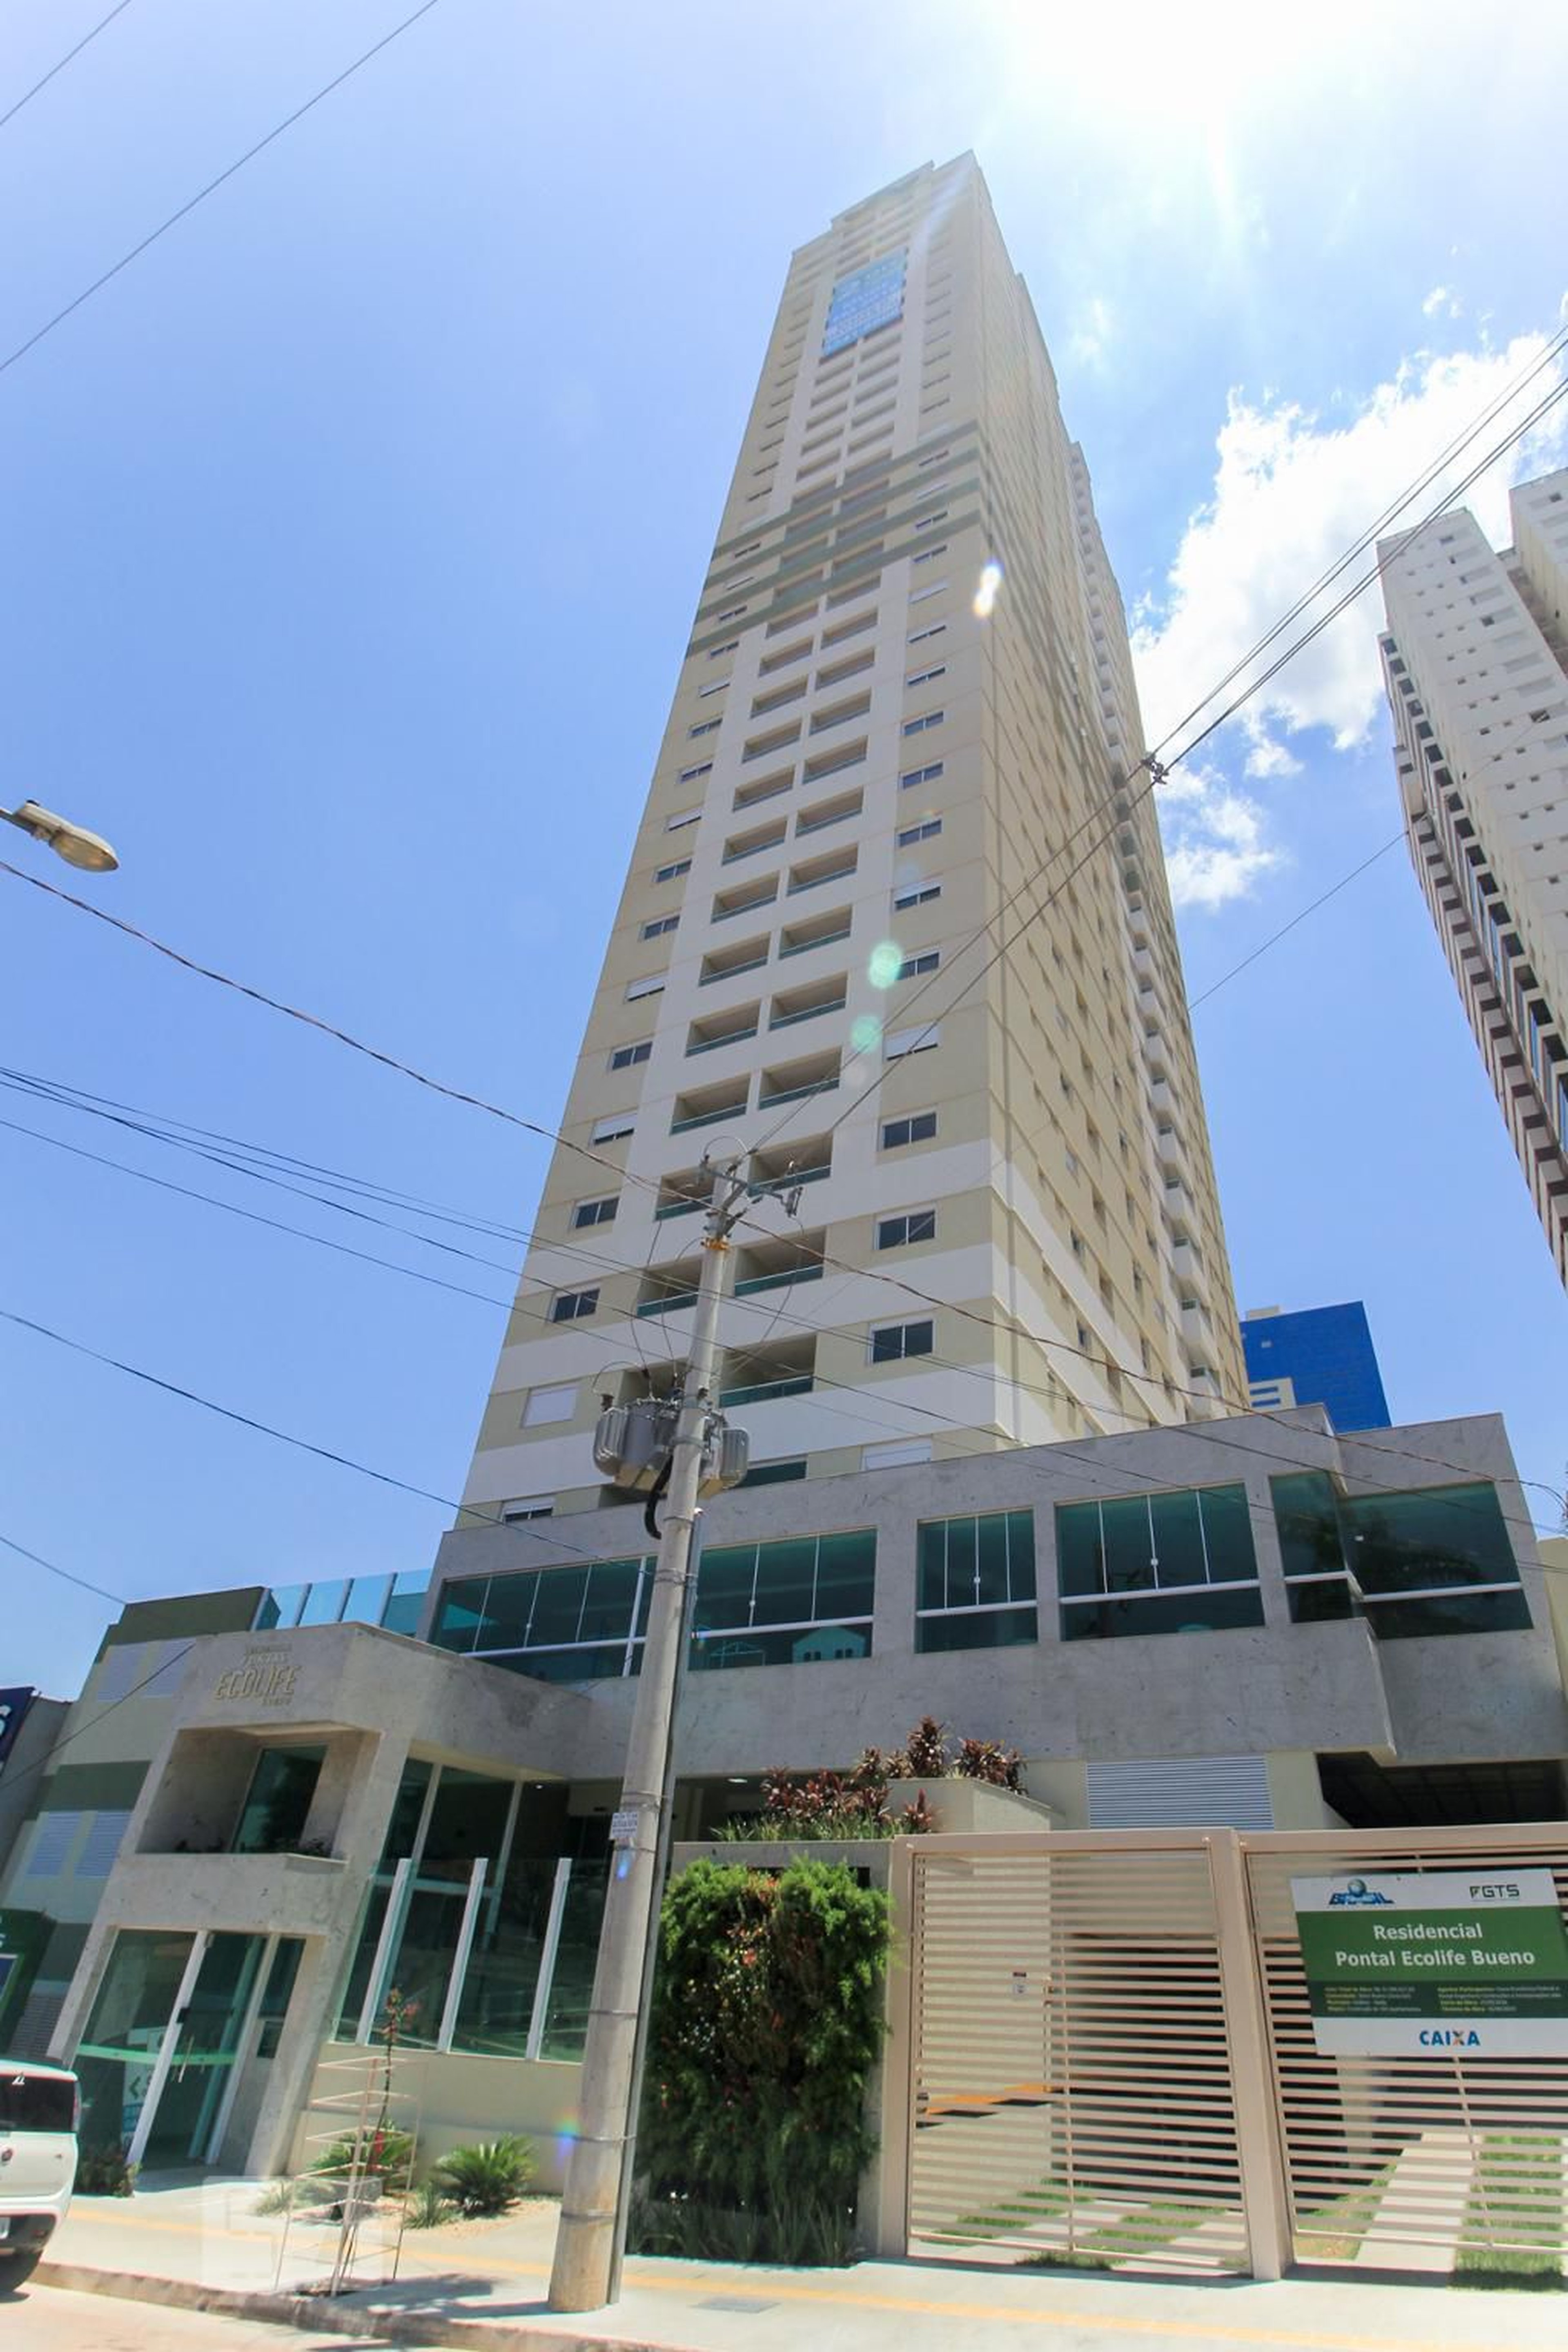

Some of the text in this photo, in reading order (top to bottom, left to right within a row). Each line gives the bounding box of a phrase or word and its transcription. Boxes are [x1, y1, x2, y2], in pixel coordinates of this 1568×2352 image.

[215, 1665, 302, 1700] ECOLIFE
[1329, 1892, 1395, 1905] BRIL
[1470, 1884, 1520, 1898] FGTS
[1373, 1923, 1483, 1940] Residencial
[1335, 1949, 1535, 1966] Pontal Ecolife Bueno
[1419, 2031, 1481, 2046] CAIXA
